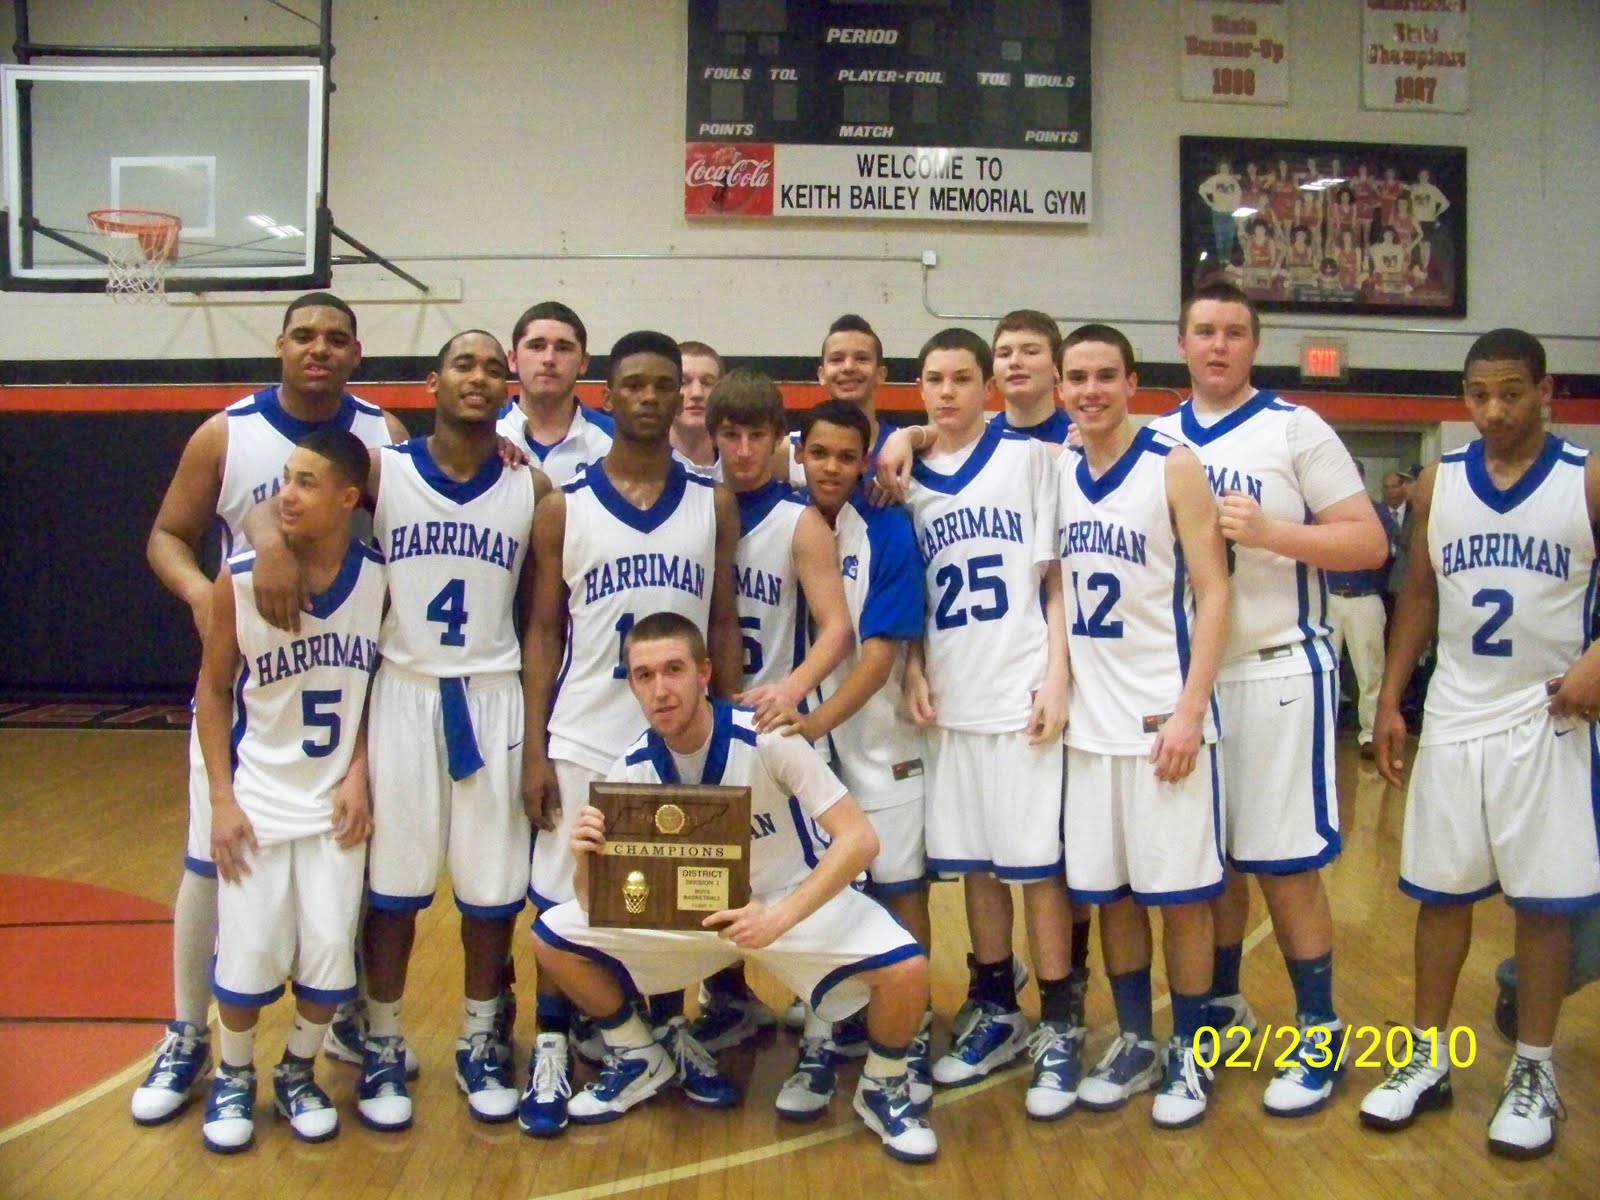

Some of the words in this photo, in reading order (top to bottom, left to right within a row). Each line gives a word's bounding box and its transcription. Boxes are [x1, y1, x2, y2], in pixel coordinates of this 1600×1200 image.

[826, 28, 899, 45] PERIOD
[704, 67, 752, 82] FOULS
[769, 68, 799, 82] TOL
[837, 69, 944, 85] PLAYER-FOUL
[978, 73, 1009, 87] TOL
[1025, 74, 1076, 88] FOULS
[699, 123, 755, 137] POINTS
[839, 125, 895, 139] MATCH
[1025, 130, 1079, 144] POINTS
[856, 153, 966, 181] WELCOME
[976, 156, 1003, 182] TO
[780, 184, 841, 209] KEITH
[850, 185, 919, 211] BAILEY
[929, 187, 1034, 213] MEMORIAL
[1044, 190, 1087, 215] GYM
[389, 521, 519, 571] HARRIMAN
[1442, 533, 1571, 581] HARRIMAN
[584, 553, 705, 605] HARRIMAN
[935, 554, 1009, 630] 25
[426, 578, 468, 647] 4
[1071, 571, 1123, 638] 12
[1472, 588, 1514, 657] 2
[256, 632, 376, 687] HARRIMAN
[302, 689, 342, 758] 5
[614, 844, 725, 858] CHAMPIONS
[682, 869, 722, 878] DISTRICT
